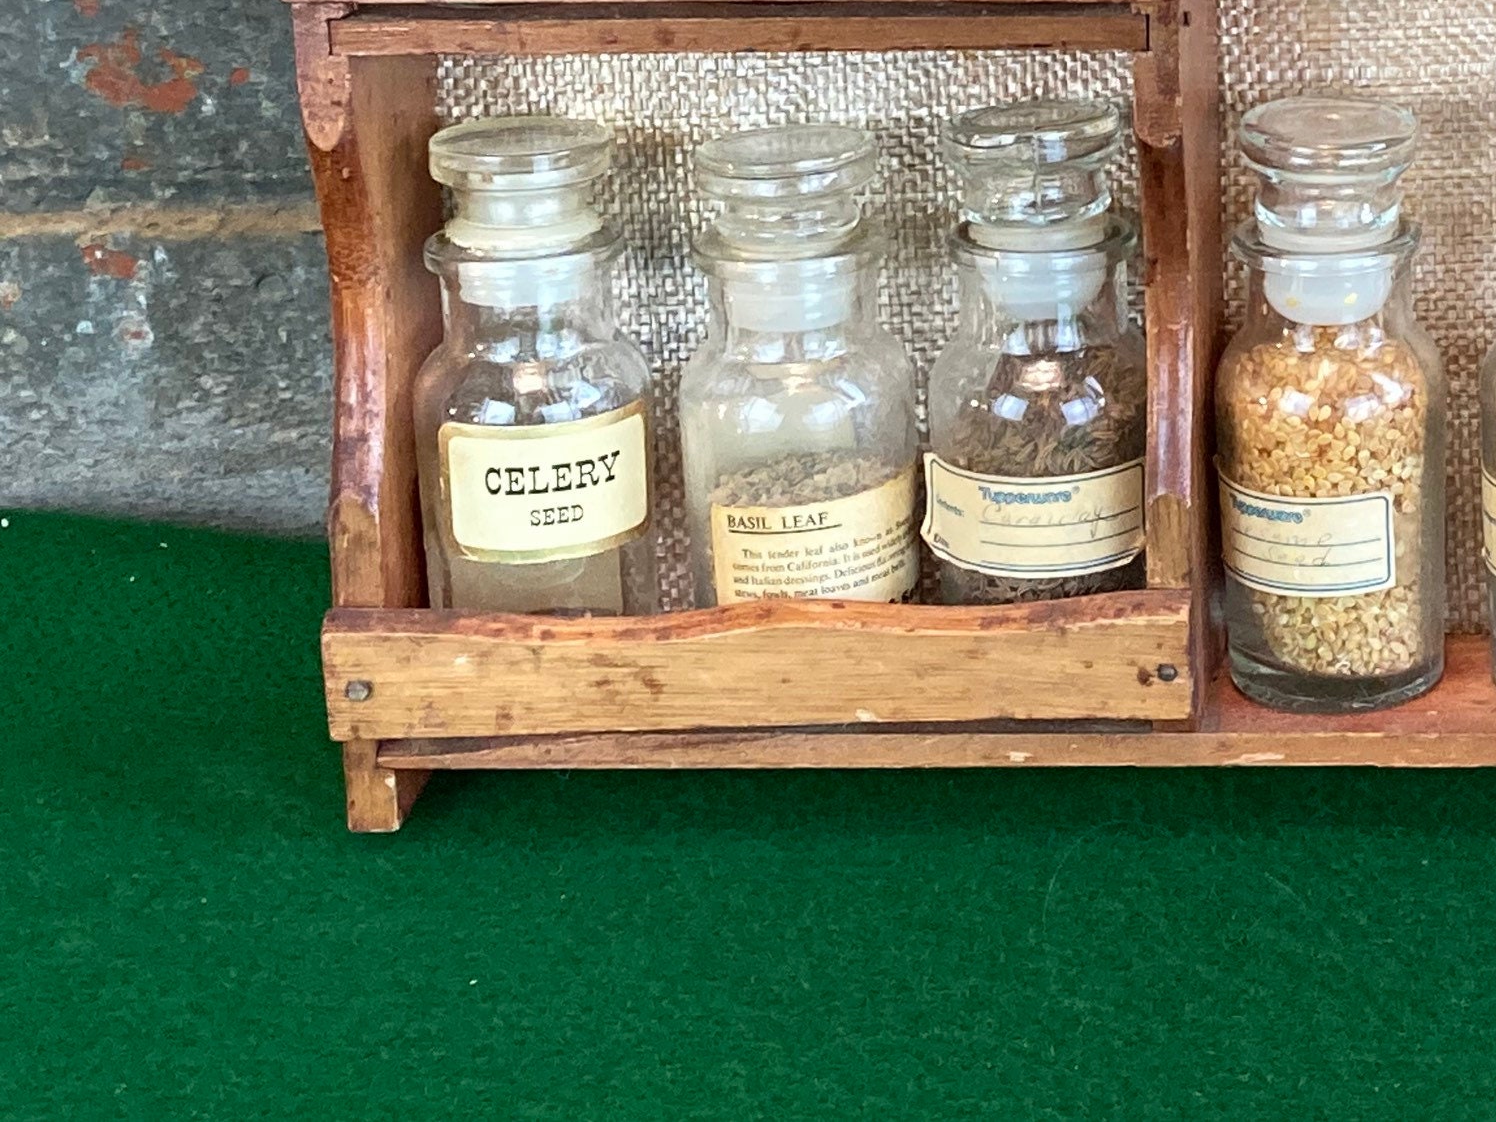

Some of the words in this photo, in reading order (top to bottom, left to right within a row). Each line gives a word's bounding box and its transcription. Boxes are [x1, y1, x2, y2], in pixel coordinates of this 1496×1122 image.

[485, 450, 620, 495] CELERY
[530, 504, 584, 526] SEED
[727, 514, 772, 529] BASIL
[782, 512, 829, 529] LEAF
[768, 549, 800, 559] tender
[805, 545, 823, 557] leaf
[762, 562, 785, 572] from
